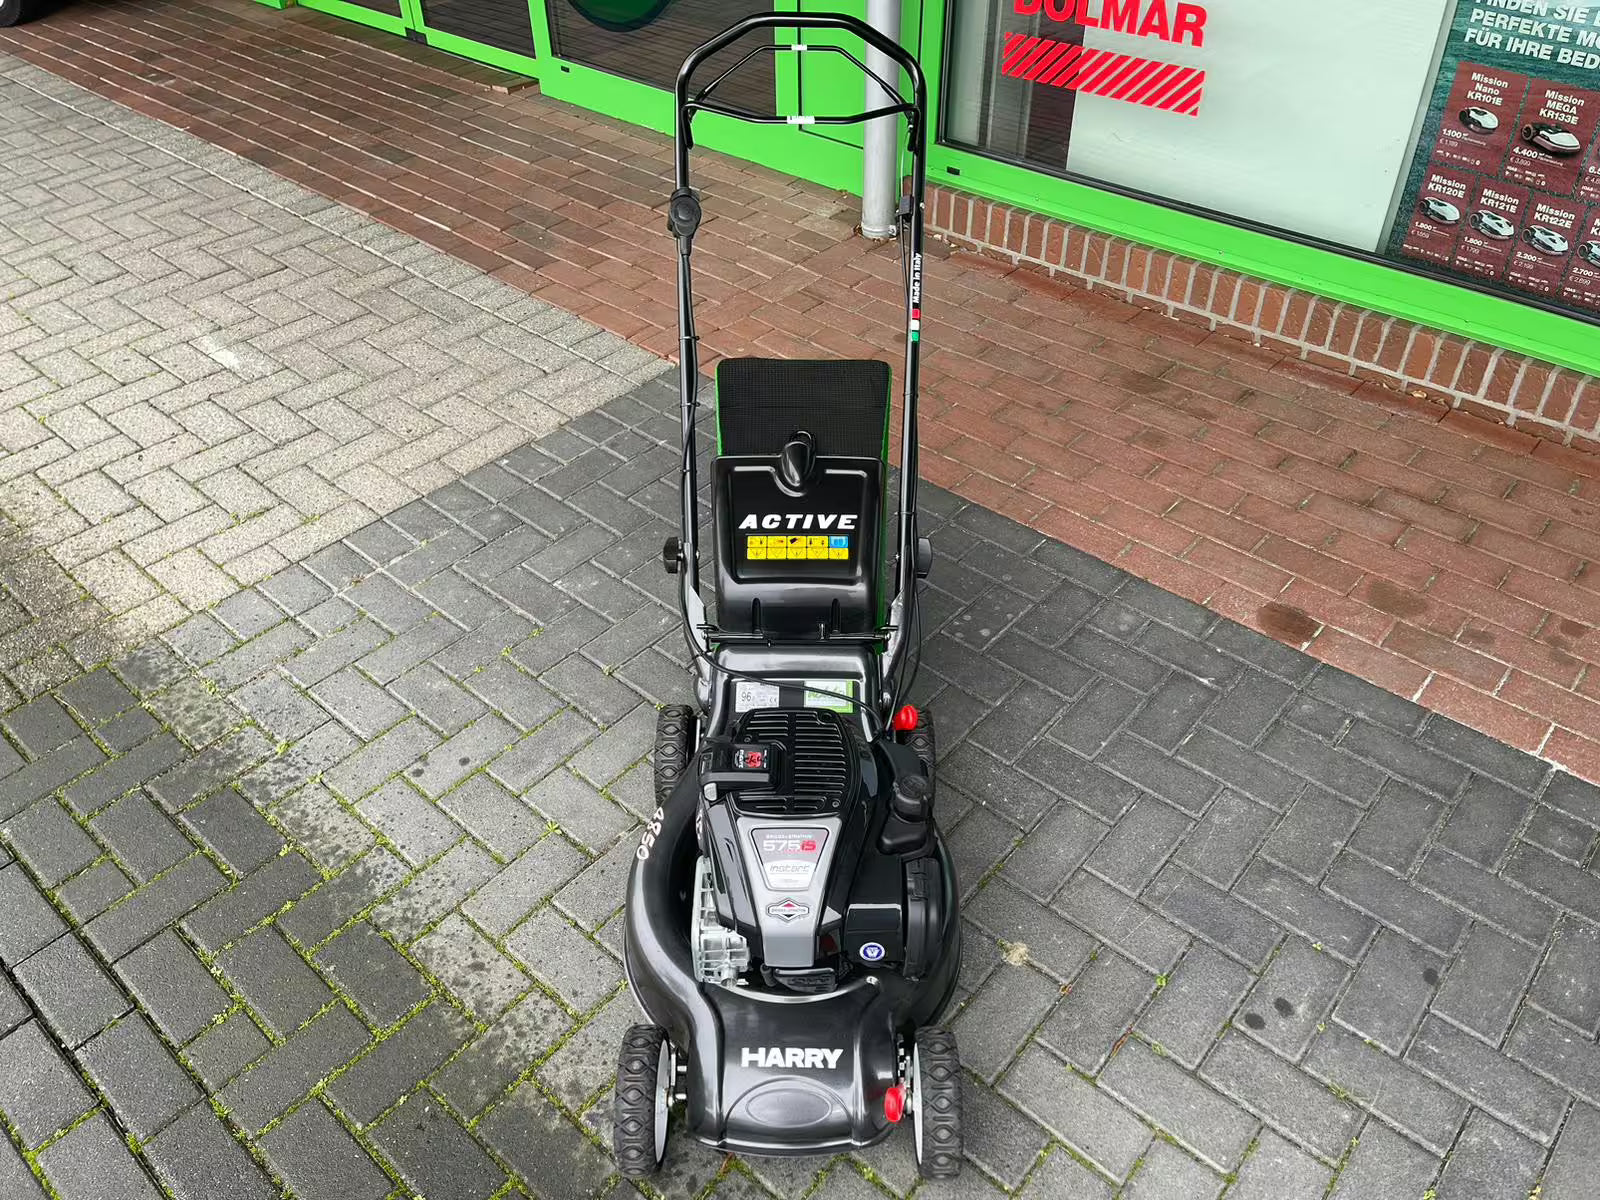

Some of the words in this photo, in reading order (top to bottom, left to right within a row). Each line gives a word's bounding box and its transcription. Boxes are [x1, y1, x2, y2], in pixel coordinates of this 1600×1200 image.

[1476, 0, 1548, 17] NDEN
[1553, 6, 1590, 24] SIE
[1470, 8, 1573, 42] PERFEKTE
[1465, 27, 1502, 49] FÜR
[1505, 36, 1554, 61] IHRE
[1557, 47, 1600, 70] BED
[1471, 72, 1508, 88] Mission
[1475, 82, 1500, 96] Nano
[1467, 90, 1503, 106] KR101E
[1545, 90, 1585, 106] Mission
[1546, 100, 1577, 115] MEGA
[1539, 108, 1579, 125] KR133E
[1512, 146, 1538, 159] 4.400
[1427, 182, 1466, 199] KR120E
[1431, 174, 1466, 190] Mission
[1480, 196, 1517, 213] KR121E
[1482, 188, 1519, 205] Mission
[1536, 203, 1576, 220] Mission
[1533, 212, 1573, 229] KR122E
[913, 252, 922, 271] Italy
[913, 272, 920, 280] in
[1572, 267, 1594, 277] 2.700
[912, 282, 920, 304] Made
[738, 514, 858, 530] ACTIVE
[636, 806, 665, 861] 4850
[741, 1047, 844, 1070] HARRY
